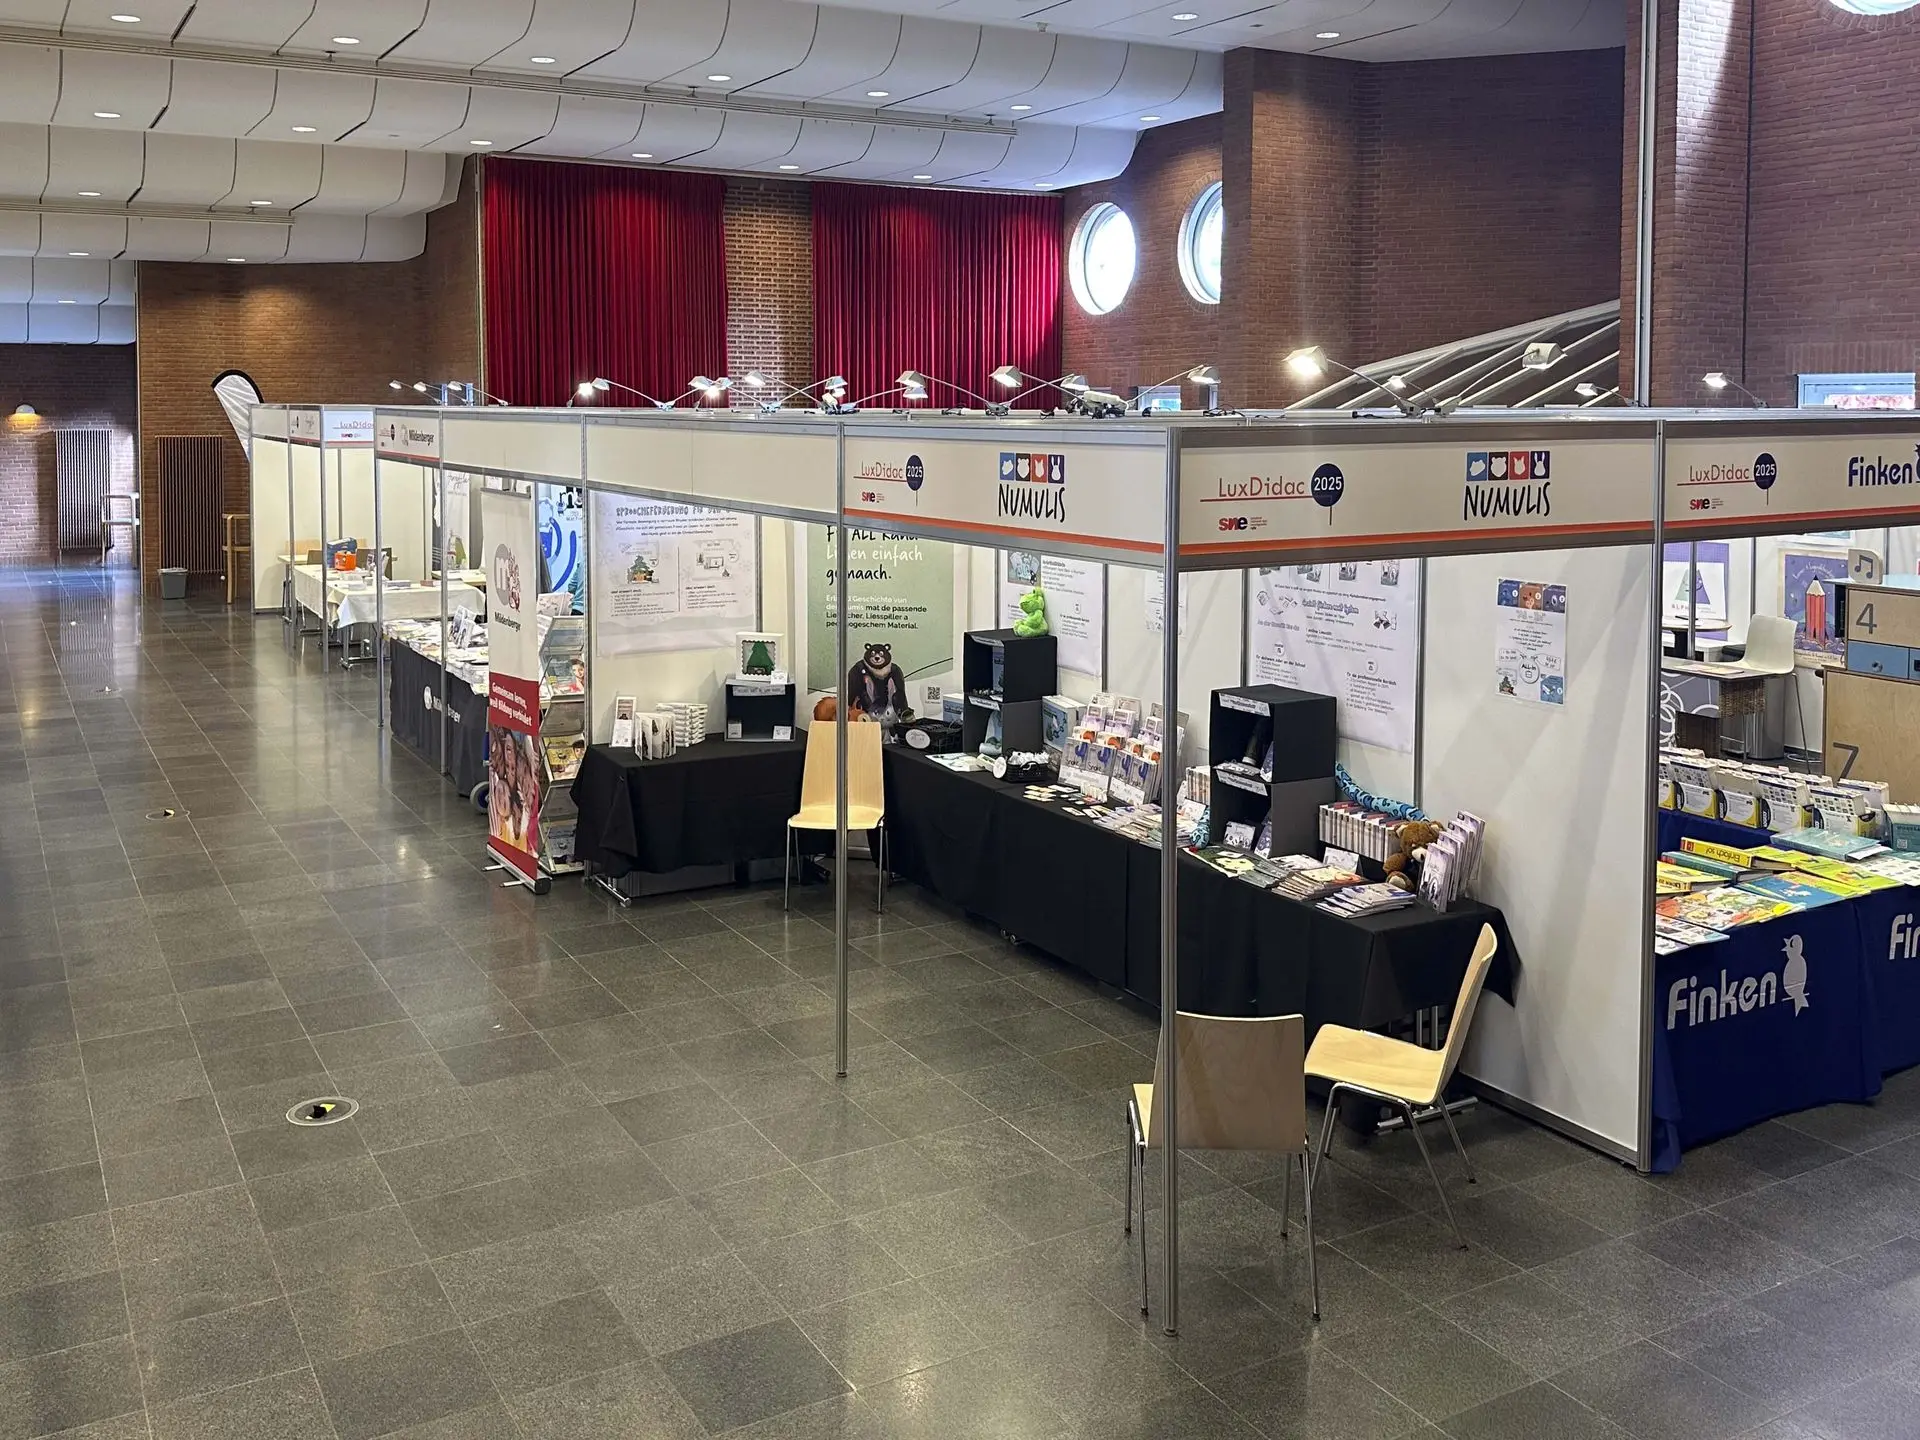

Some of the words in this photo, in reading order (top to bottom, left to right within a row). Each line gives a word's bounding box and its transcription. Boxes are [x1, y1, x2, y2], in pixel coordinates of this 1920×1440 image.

[860, 461, 903, 479] LuxDidac
[907, 463, 923, 478] 2025
[1689, 463, 1750, 482] LuxDidac
[1755, 463, 1776, 476] 2025
[1848, 455, 1913, 487] Finken
[1218, 475, 1305, 497] LuxDidac
[1313, 476, 1343, 491] 2025
[998, 483, 1066, 523] NUMULIS
[1463, 481, 1551, 521] NUMULIS
[872, 543, 923, 567] einfach
[892, 605, 927, 613] passende
[1855, 603, 1877, 634] 4
[887, 621, 919, 630] Material.
[1832, 742, 1859, 784] 7
[1717, 849, 1741, 863] Einfach
[1667, 968, 1778, 1031] Finken
